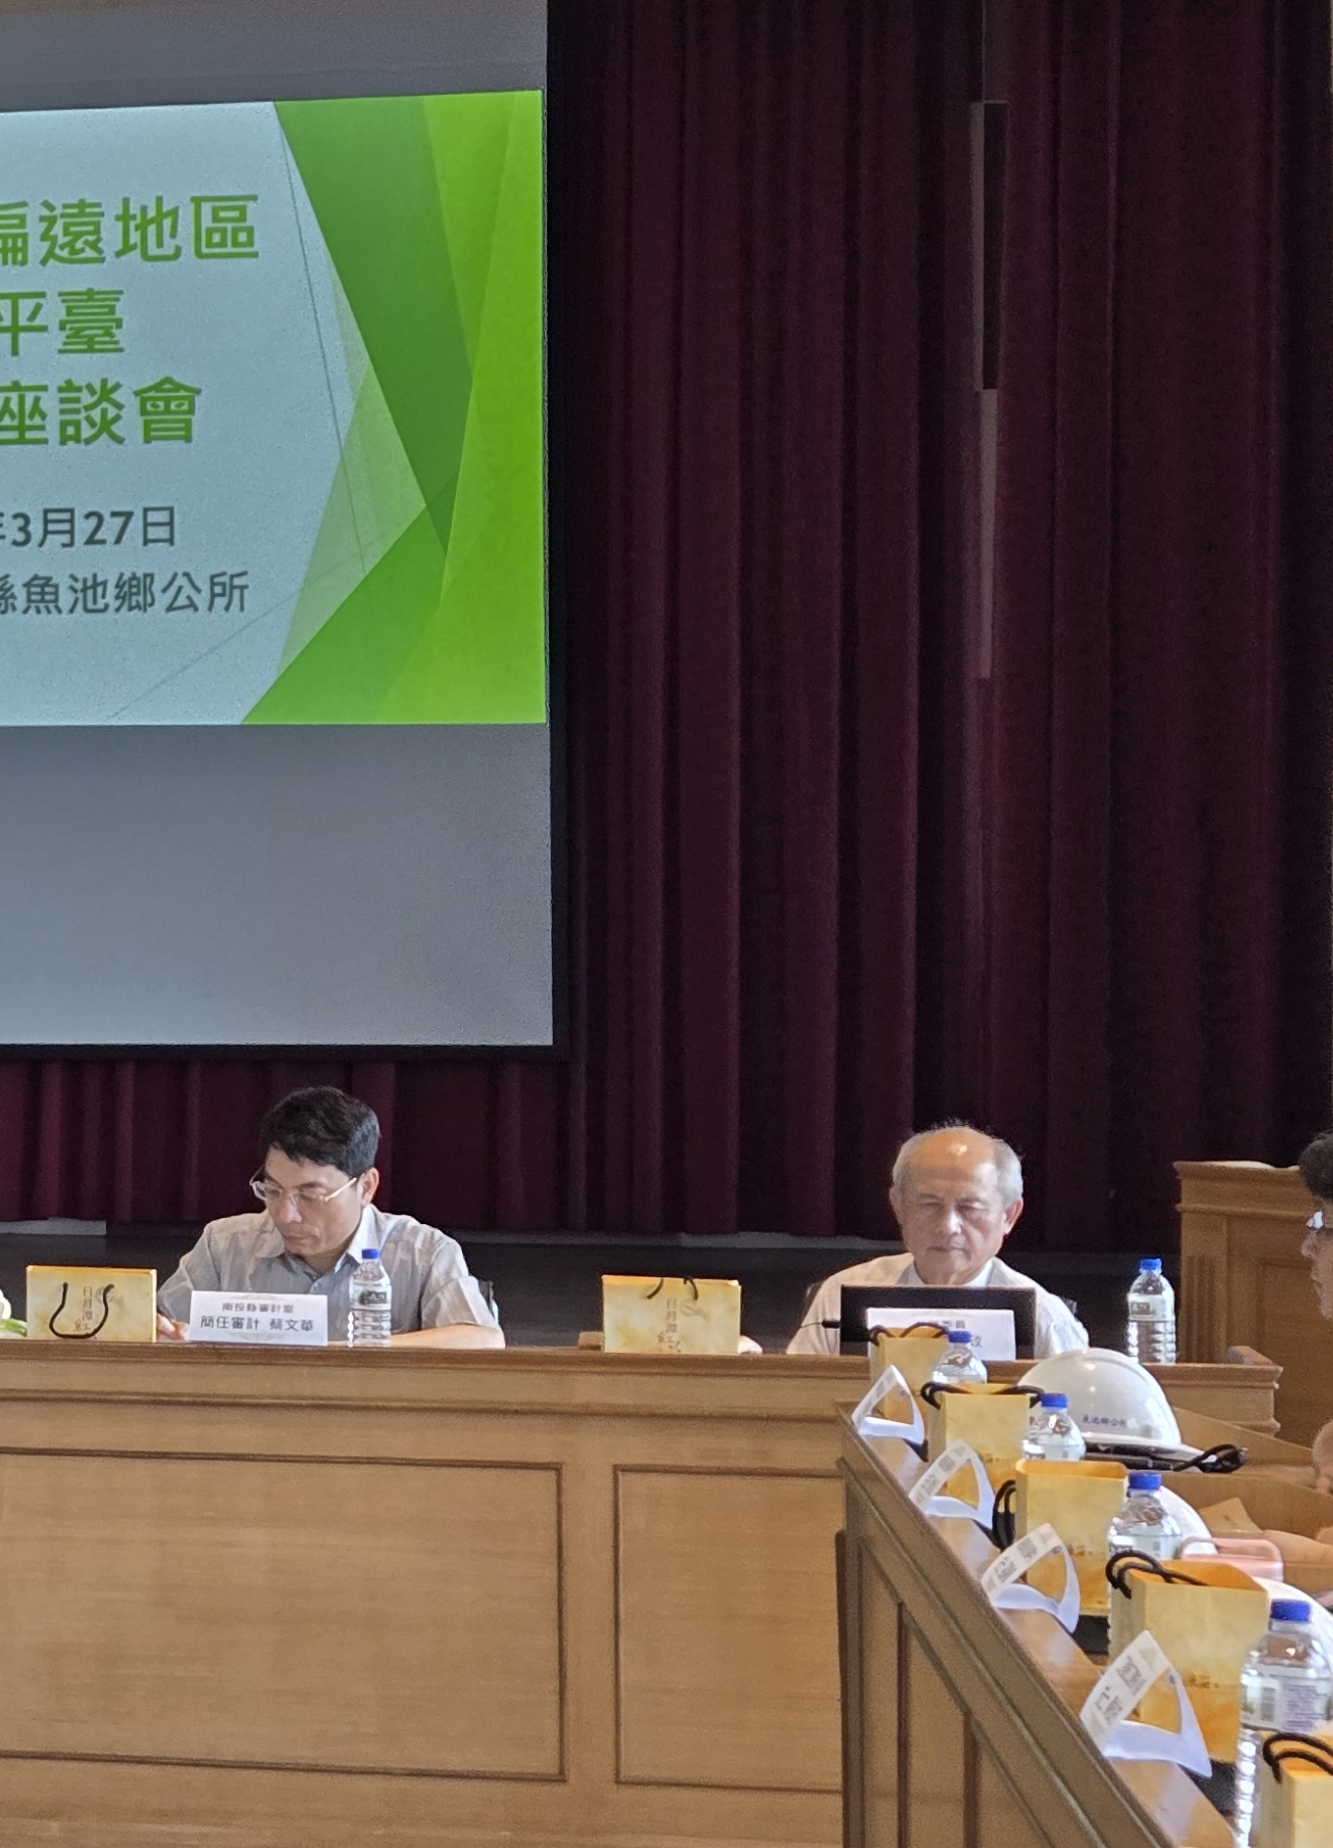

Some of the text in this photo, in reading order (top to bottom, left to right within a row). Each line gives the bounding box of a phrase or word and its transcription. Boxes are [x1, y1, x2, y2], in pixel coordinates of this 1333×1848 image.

[221, 1302, 294, 1314] 南投縣審計室
[200, 1315, 314, 1332] 簡任審計 蔡文華
